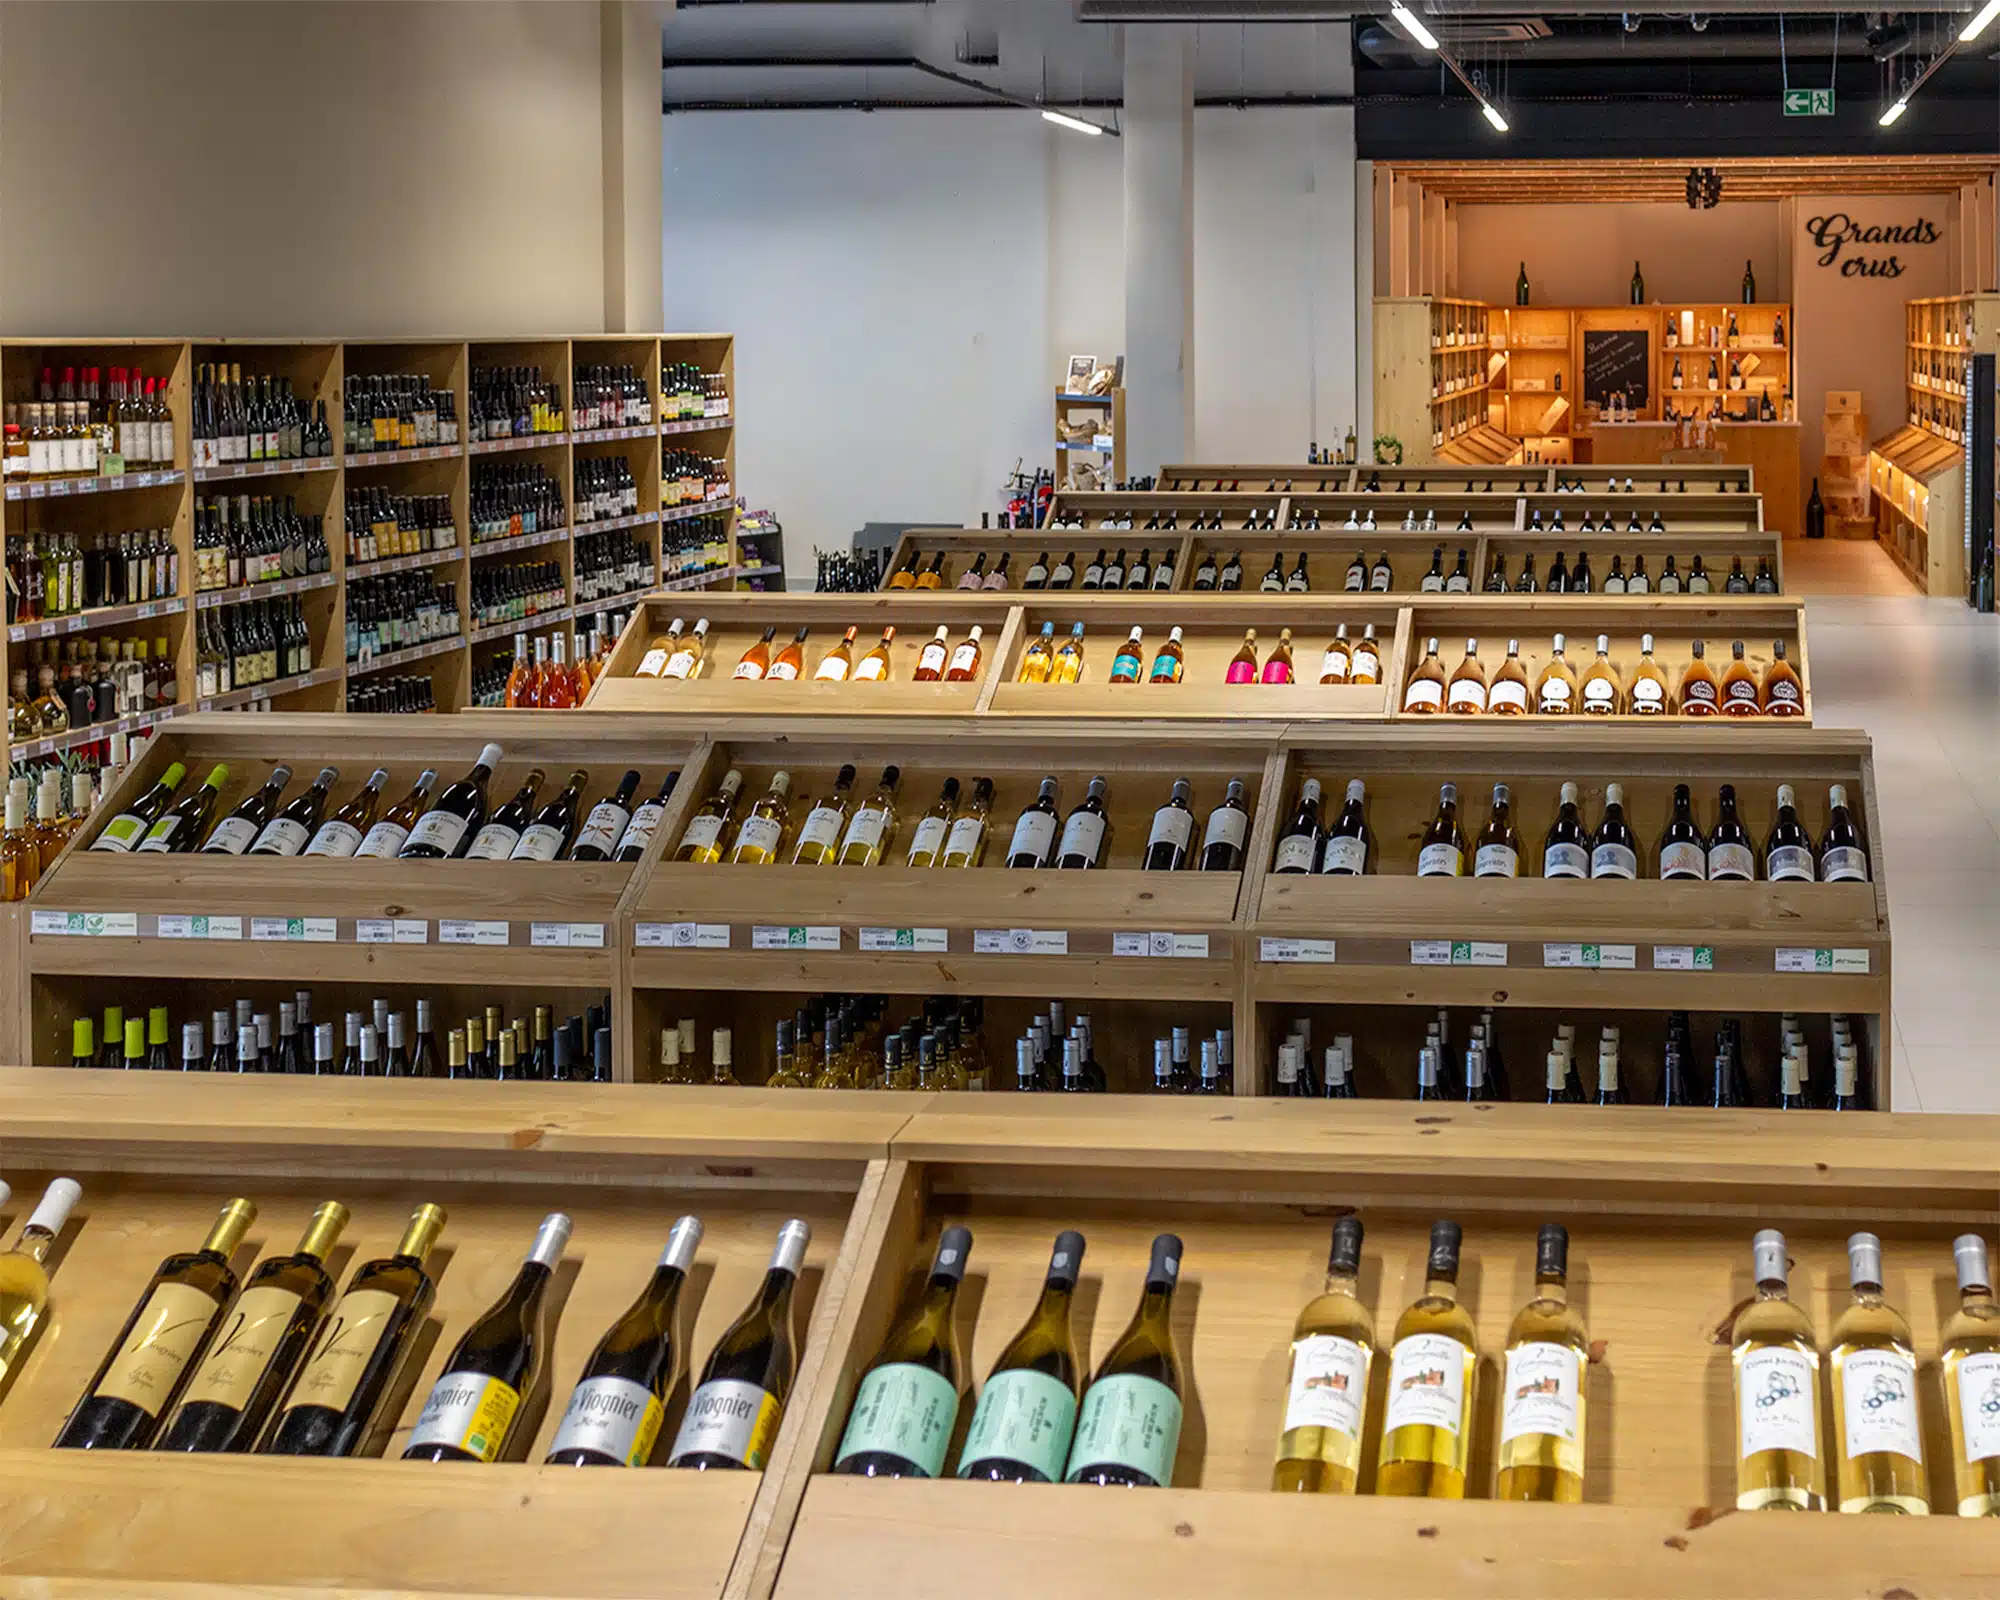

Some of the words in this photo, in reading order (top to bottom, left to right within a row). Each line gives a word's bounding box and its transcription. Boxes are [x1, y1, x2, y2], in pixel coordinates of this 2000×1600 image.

[1806, 213, 1942, 267] Grands
[1841, 255, 1907, 278] crus
[578, 1387, 639, 1421] Viognier
[693, 1391, 754, 1421] Viognier
